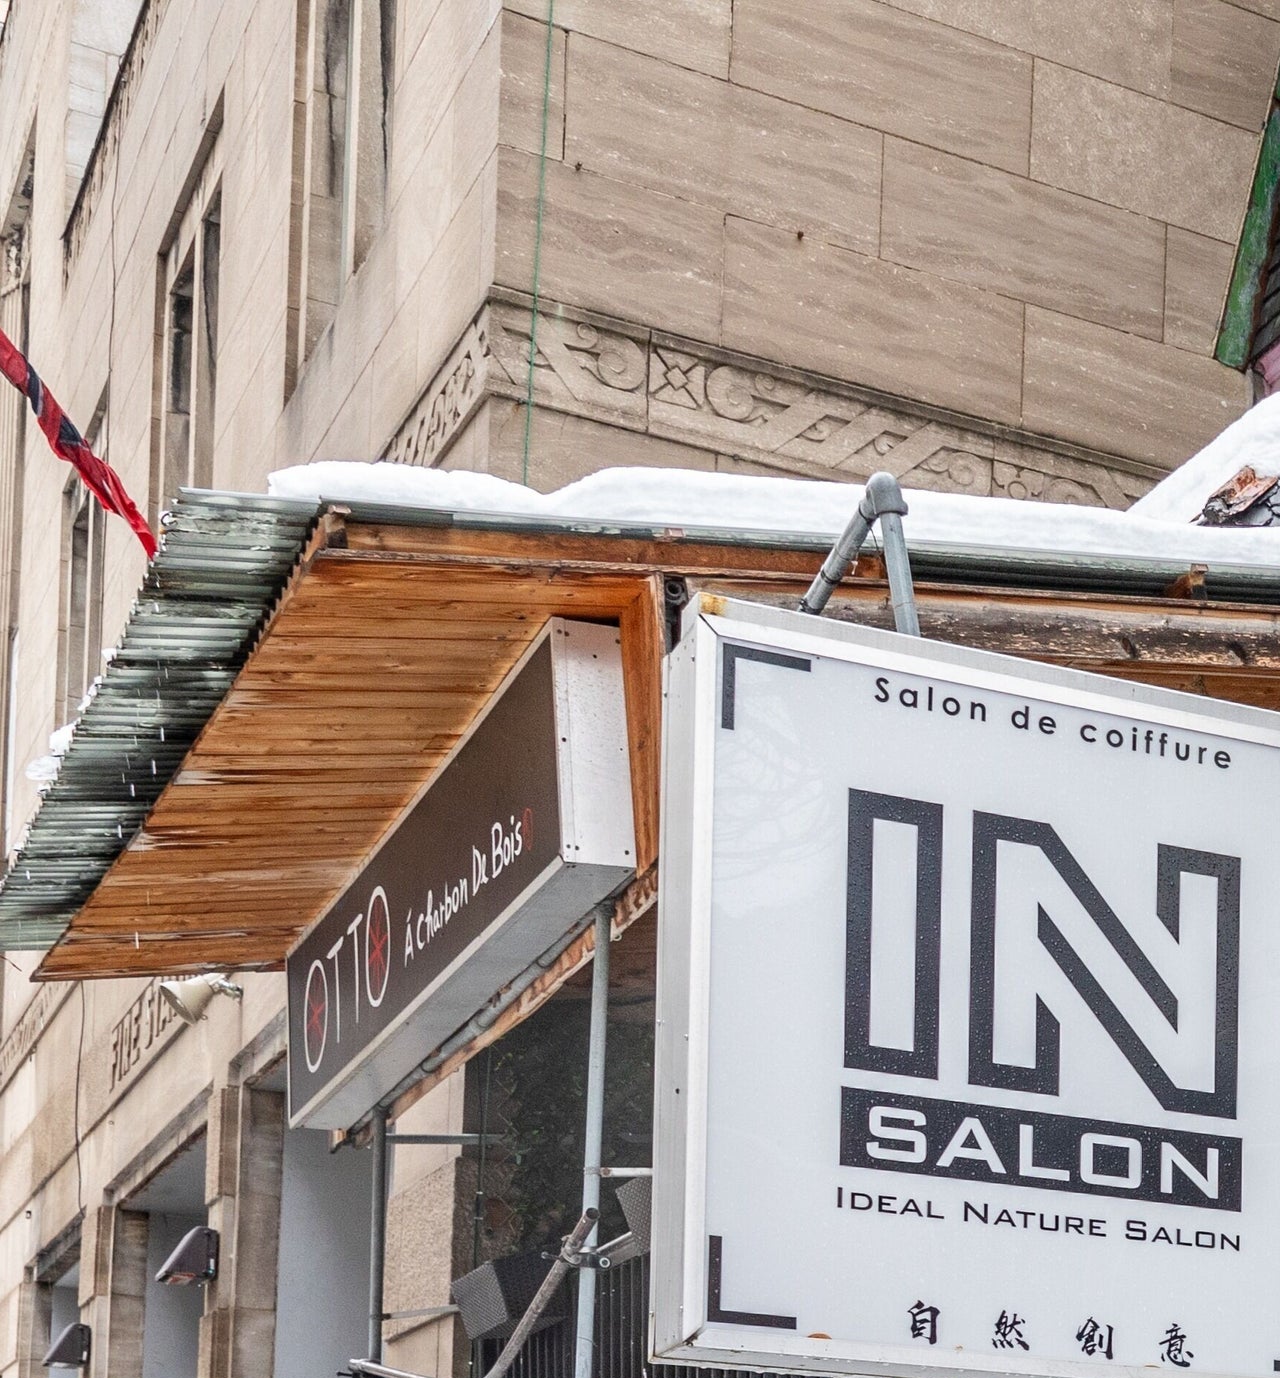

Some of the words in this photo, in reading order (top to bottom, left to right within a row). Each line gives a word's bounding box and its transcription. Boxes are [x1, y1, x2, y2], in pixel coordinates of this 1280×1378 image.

[873, 676, 988, 723] Salon
[1011, 703, 1058, 737] de
[1080, 723, 1233, 770] coiffure
[304, 886, 390, 1073] OTTO
[472, 844, 489, 897] De
[491, 815, 523, 879] Bois
[843, 787, 1241, 1119] IN
[866, 1106, 1219, 1199] SALON
[836, 1185, 945, 1221] IDEAL
[963, 1203, 1108, 1239] NATURE
[1125, 1220, 1242, 1253] SALON
[906, 1299, 1195, 1368] 自然創意
